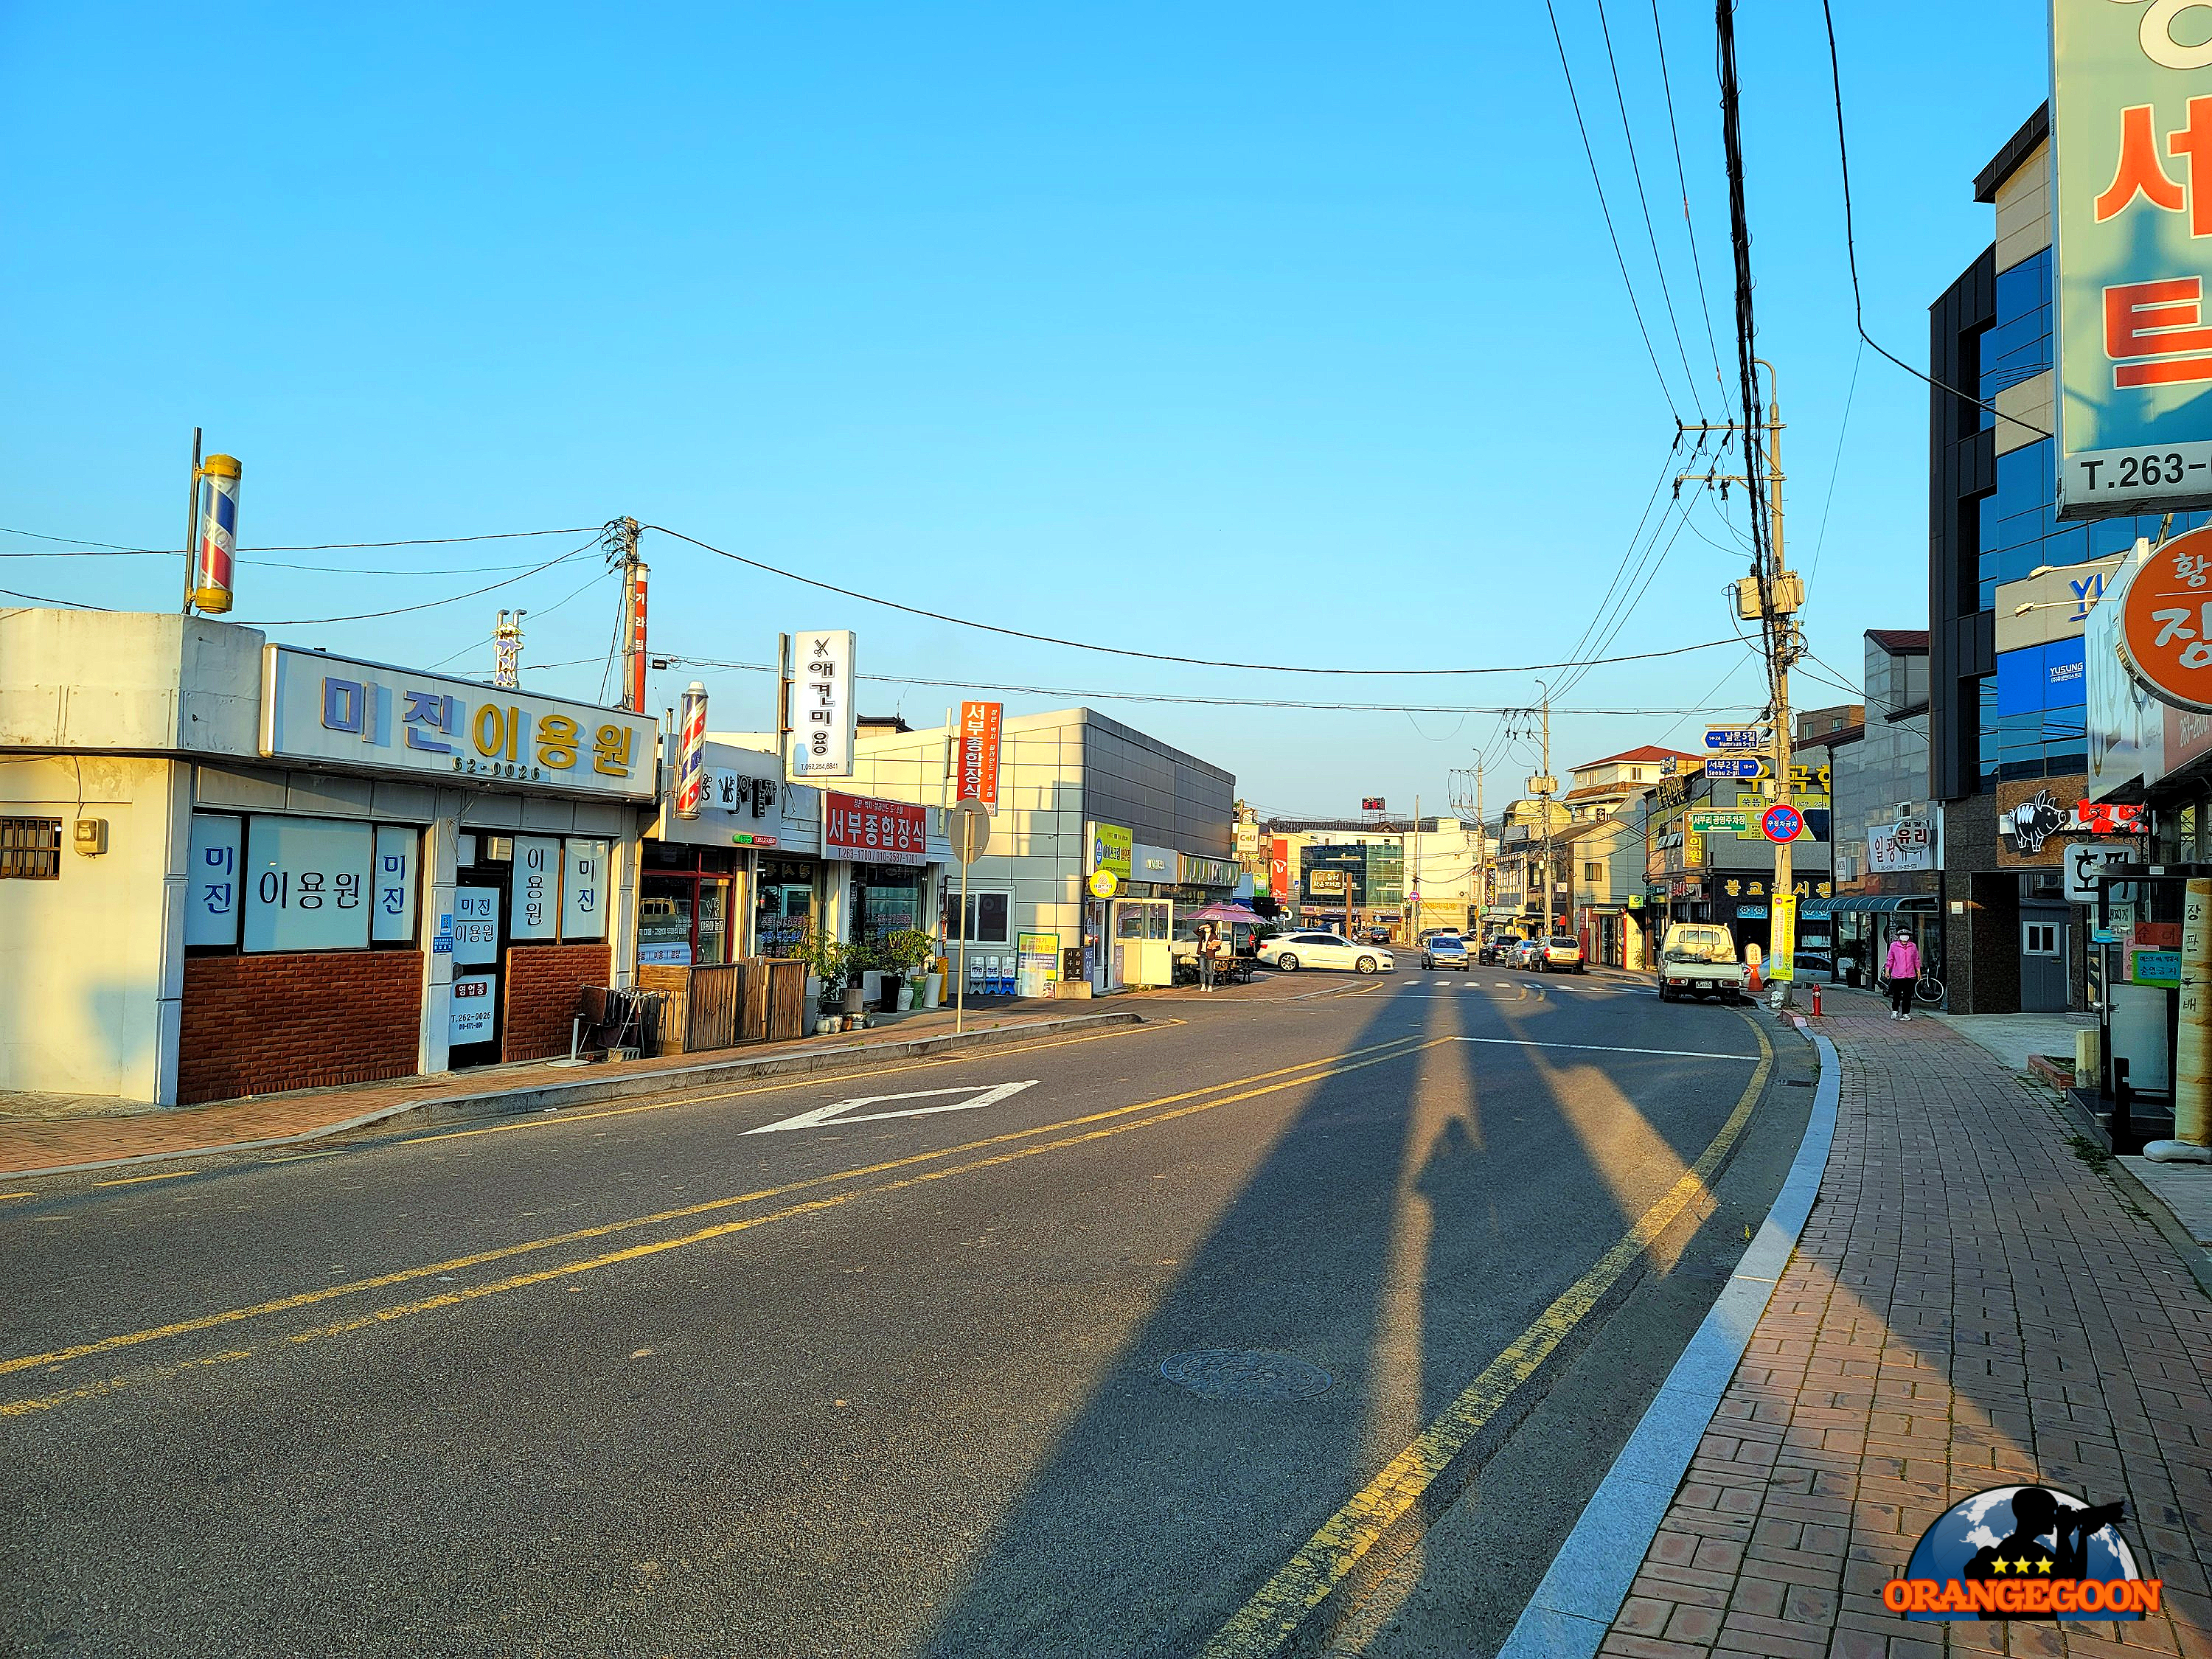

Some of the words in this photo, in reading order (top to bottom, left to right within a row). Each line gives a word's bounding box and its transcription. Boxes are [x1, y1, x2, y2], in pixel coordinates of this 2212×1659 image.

[2079, 456, 2212, 491] T.263-
[2050, 661, 2084, 676] YUSUNG
[808, 661, 835, 757] 애견미용
[1725, 731, 1756, 742] 남문5길
[963, 704, 986, 800] 서부종합장식
[452, 757, 541, 781] 62-0026
[1708, 761, 1739, 769] 서부2길
[828, 808, 925, 851] 서부종합장식
[1693, 815, 1713, 825] 서부리
[1713, 814, 1746, 825] 공영주차장
[1767, 819, 1798, 827] 주정차금지
[1897, 828, 1927, 844] 유리
[203, 846, 234, 915] 미진
[259, 871, 361, 909] 이용원
[382, 854, 406, 915] 미진
[525, 848, 545, 926] 이용원
[577, 859, 597, 913] 미진
[461, 898, 490, 916] 미진
[455, 924, 494, 943] 이용원
[459, 984, 484, 996] 영업중
[451, 1012, 491, 1023] T.262-0026
